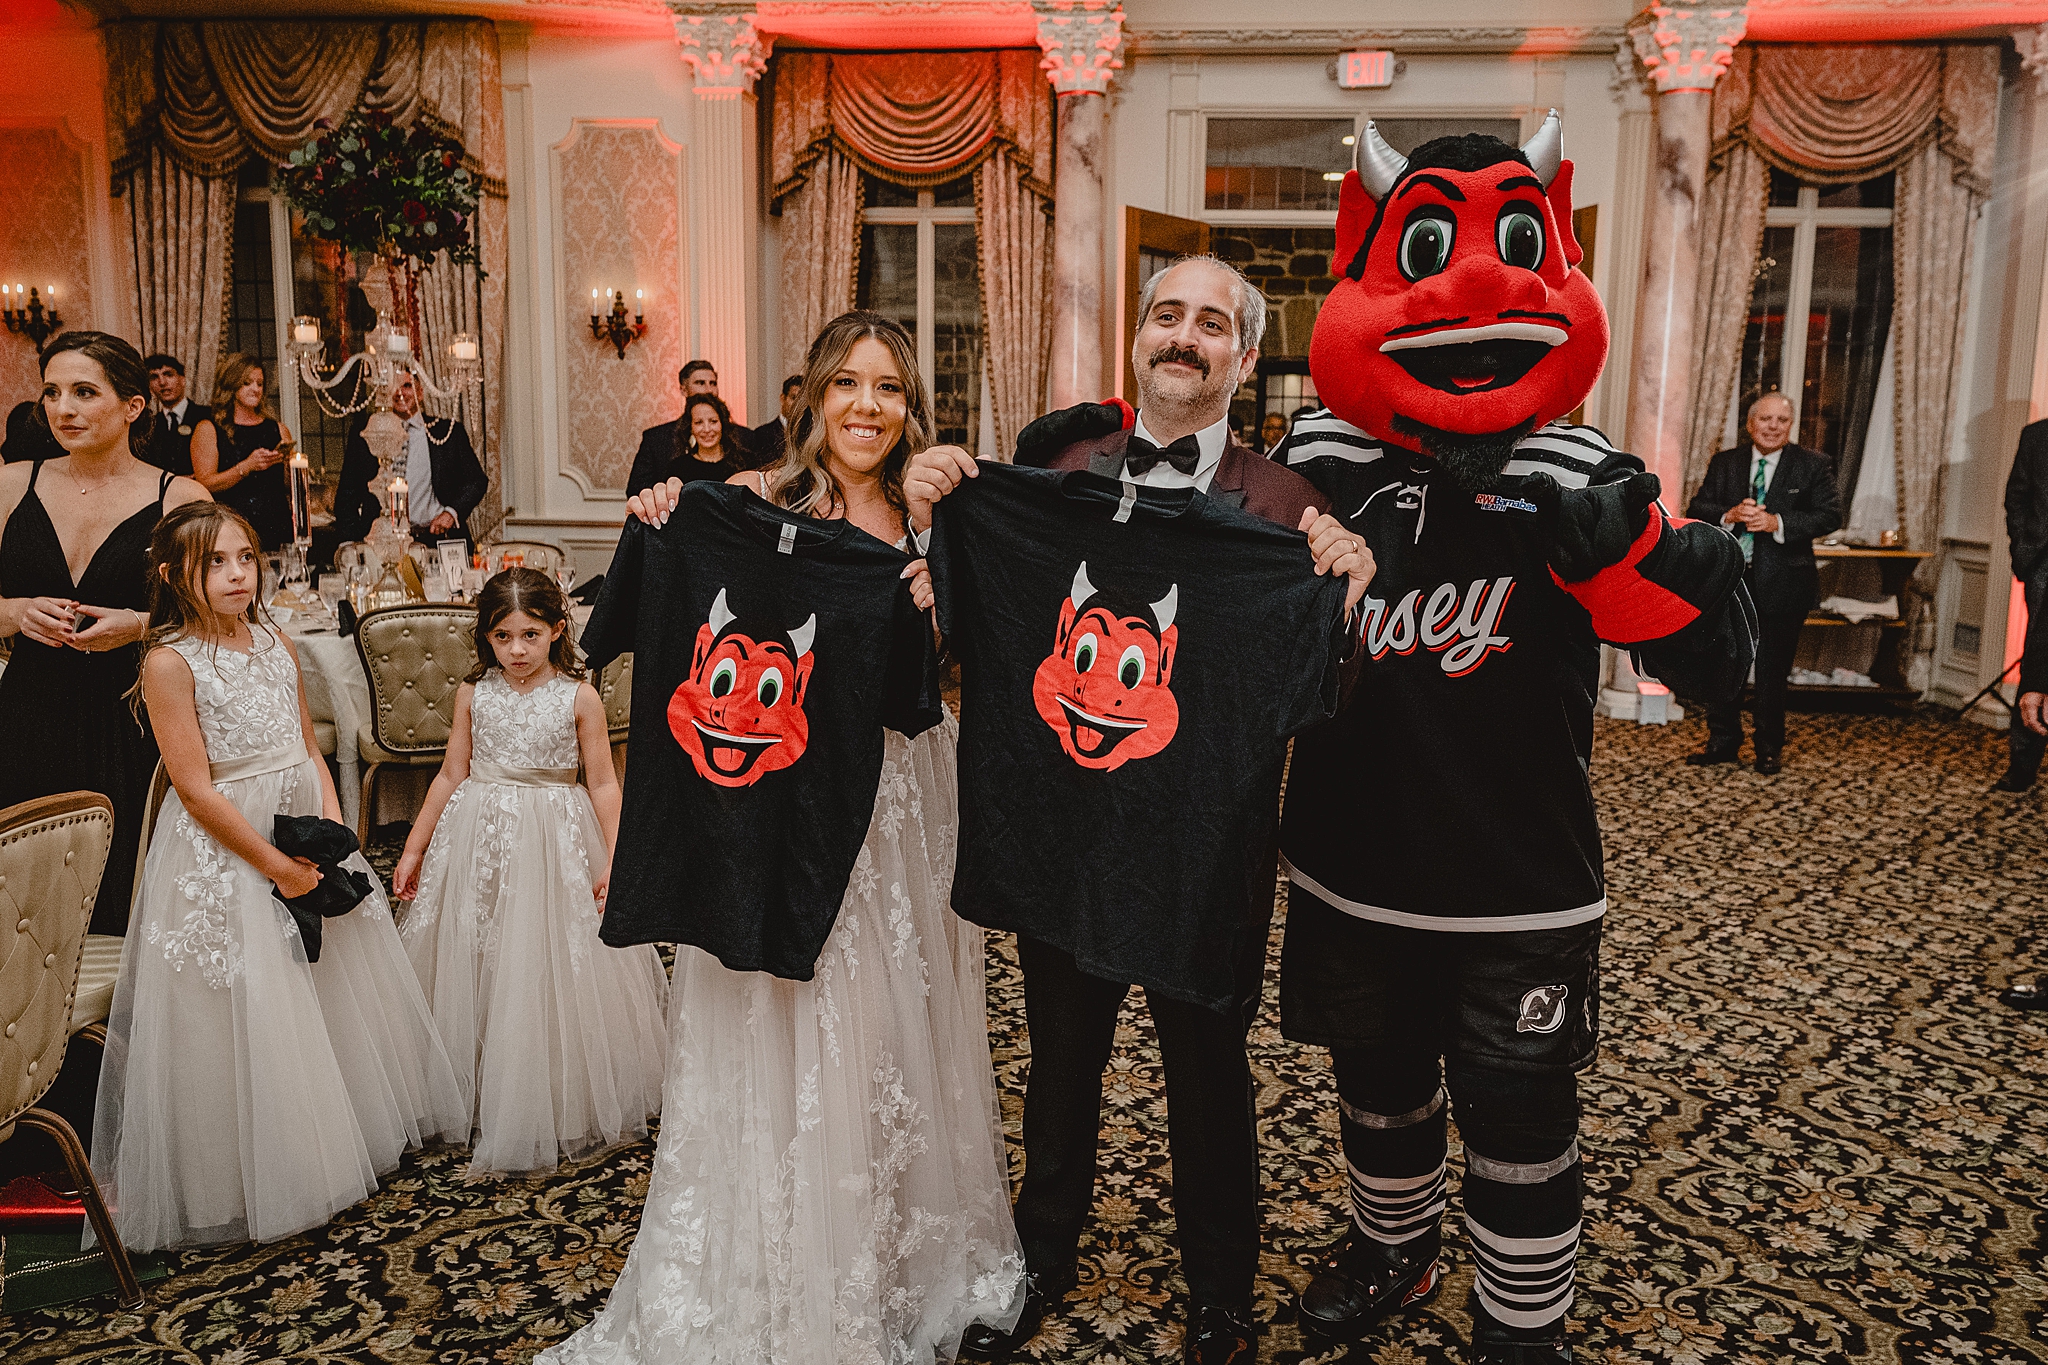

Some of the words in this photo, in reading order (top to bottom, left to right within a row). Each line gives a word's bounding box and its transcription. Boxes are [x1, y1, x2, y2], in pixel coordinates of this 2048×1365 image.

[1346, 52, 1387, 86] EXIT
[1475, 494, 1537, 512] RWJBarnabas
[1345, 576, 1516, 678] rsey
